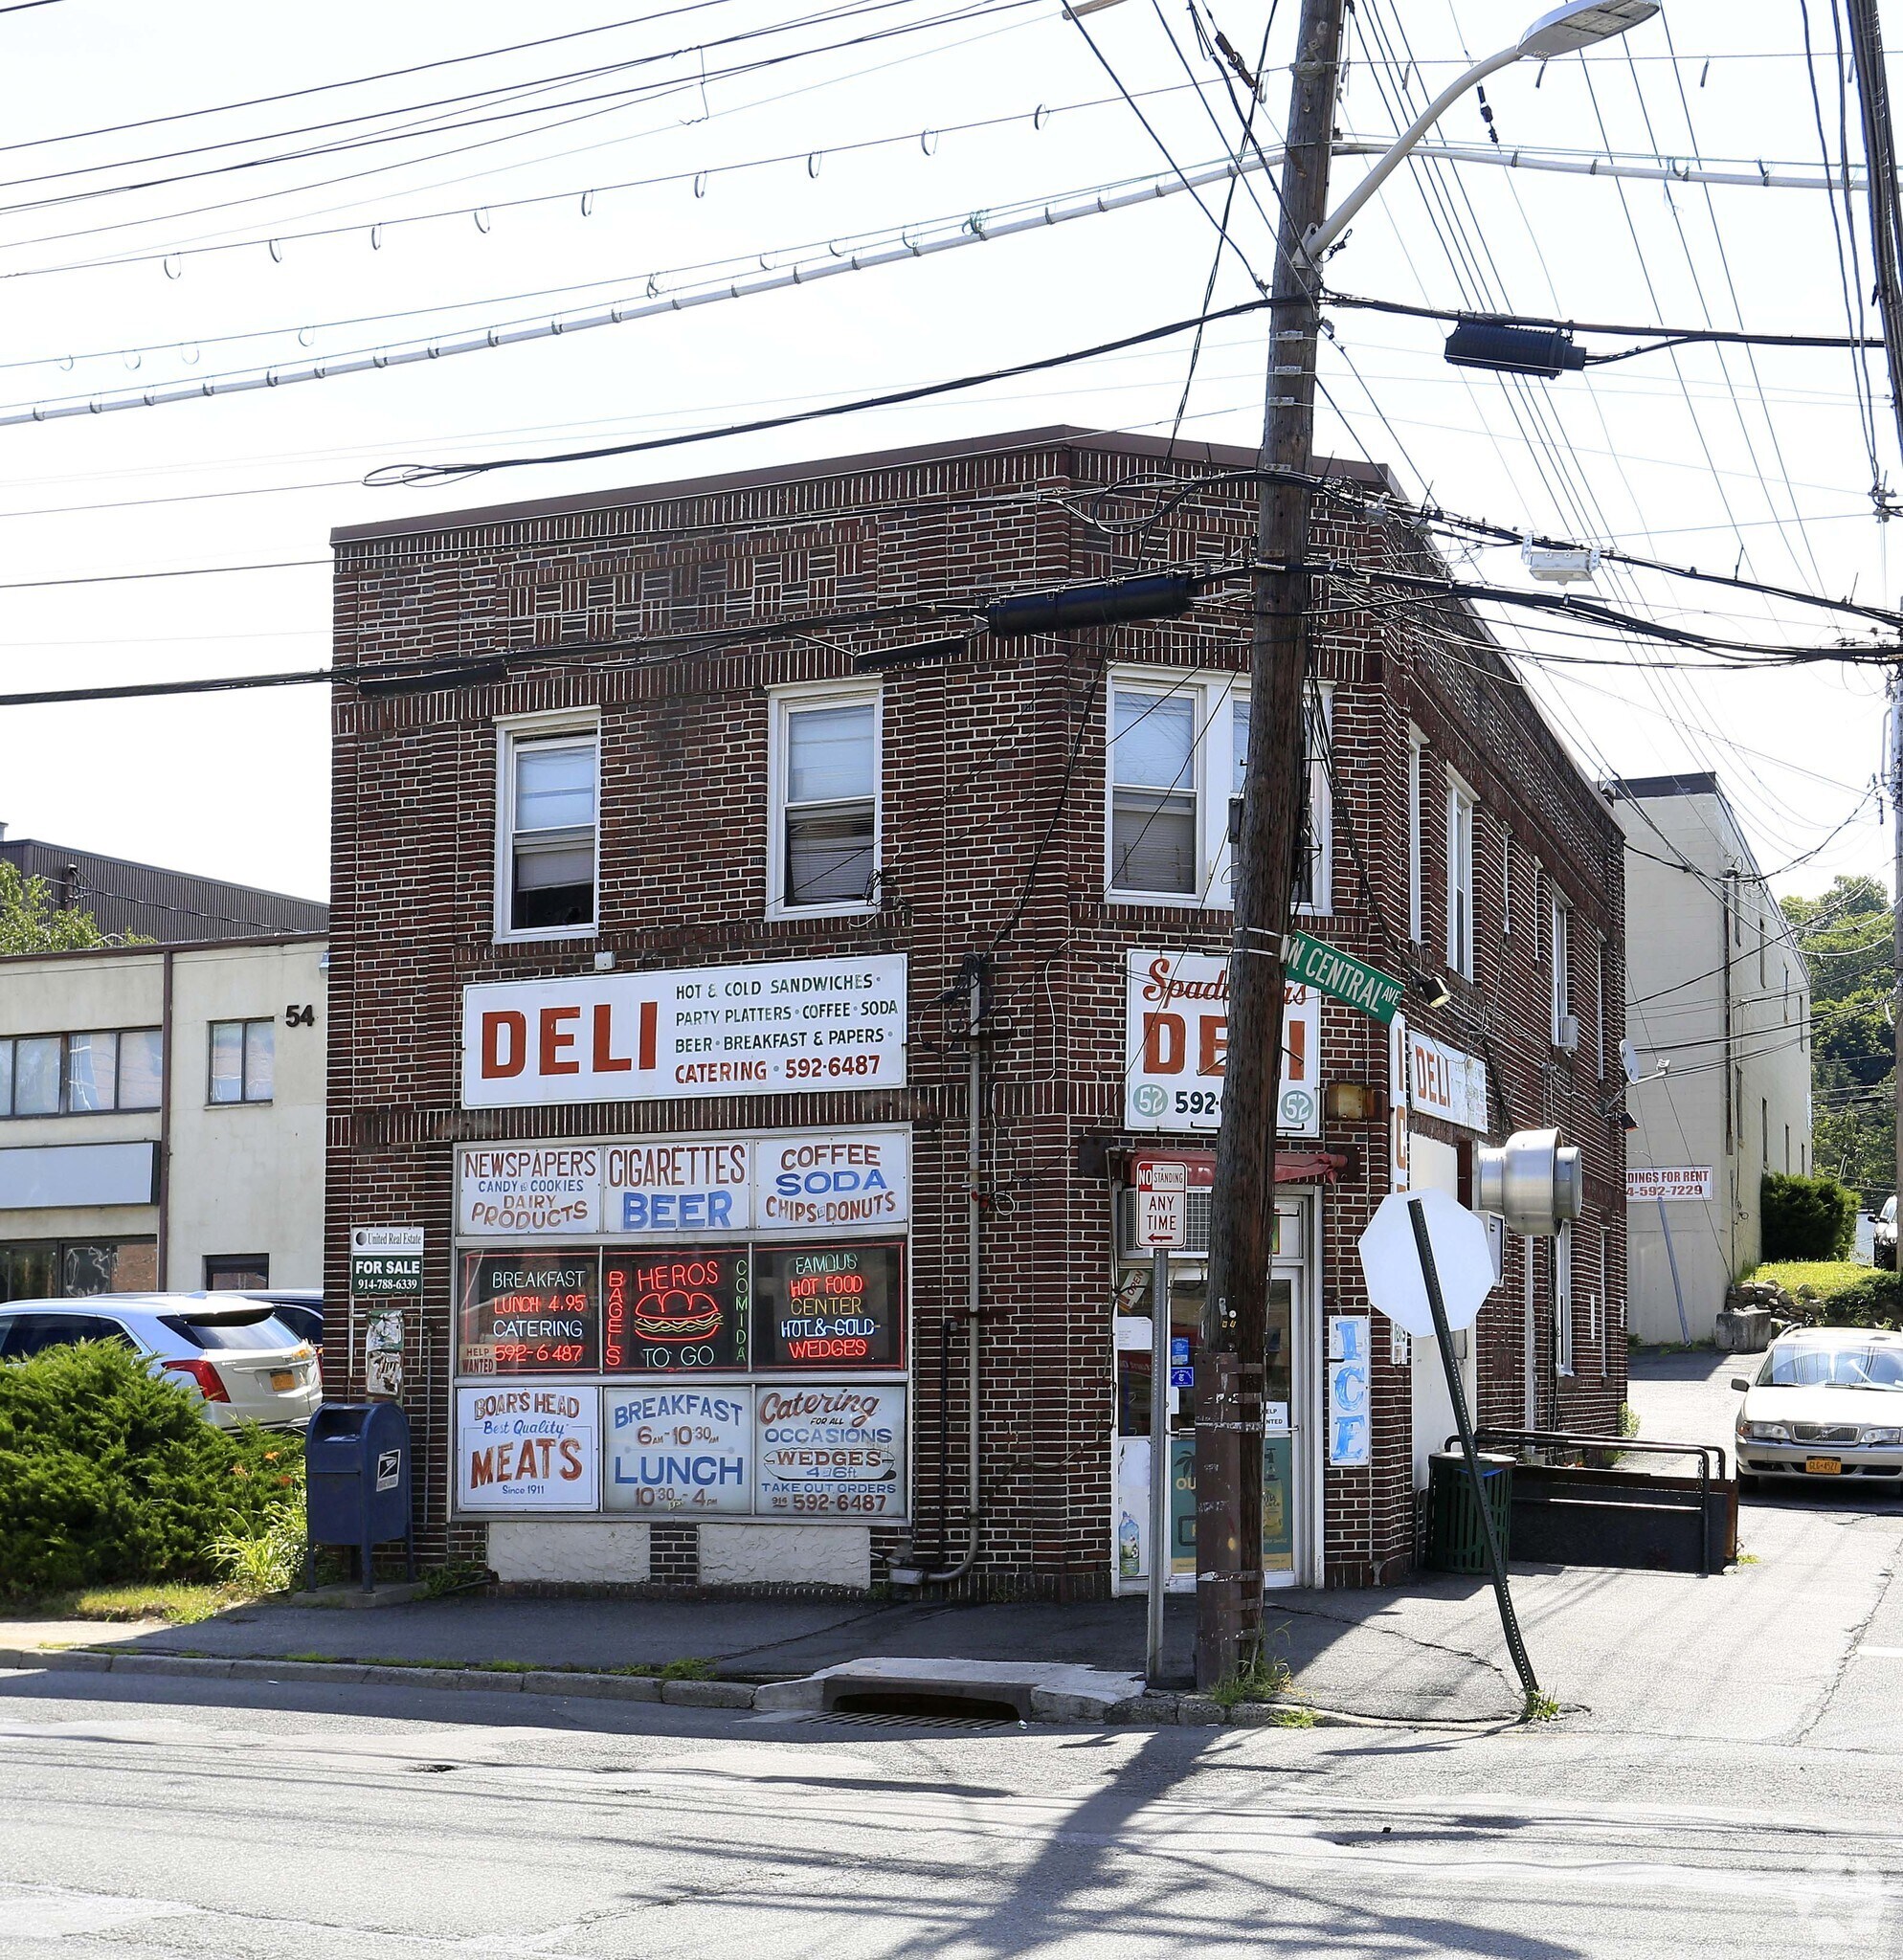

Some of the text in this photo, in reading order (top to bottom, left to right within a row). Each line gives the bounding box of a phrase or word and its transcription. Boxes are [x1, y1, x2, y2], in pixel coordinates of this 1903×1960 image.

[676, 973, 873, 1000] HOT & COLD SANDWICHES
[1305, 947, 1383, 1013] CENTRAL
[1381, 986, 1401, 1006] AVE
[285, 1005, 315, 1027] 54
[676, 1000, 899, 1026] PARTY PLATTERS COFFEE SODA
[481, 1001, 659, 1080] DELI
[675, 1028, 884, 1054] BEER BREAKFAST & PAPERS
[1143, 1012, 1305, 1081] DEI
[675, 1060, 767, 1084] CATERING
[1415, 1044, 1451, 1108] DELI
[1138, 1086, 1164, 1114] 52
[1285, 1094, 1310, 1120] 52
[464, 1150, 596, 1178] NEWSPAPERS
[609, 1145, 746, 1188] CIGARETTES
[780, 1144, 882, 1170] COFFEE
[479, 1180, 518, 1192] CANDY
[530, 1179, 584, 1192] COOKIES
[775, 1169, 887, 1196] SODA
[1139, 1169, 1183, 1186] NO STANDING
[1627, 1170, 1709, 1184] DINGS FOR RENT
[504, 1194, 556, 1209] DAIRY
[1626, 1185, 1703, 1196] 4-592-7229
[623, 1190, 732, 1229] BEER
[766, 1195, 817, 1223] CHIPS
[826, 1191, 896, 1223] DONUTS
[1149, 1195, 1175, 1211] ANY
[471, 1200, 588, 1230] PRODUCTS
[1147, 1214, 1176, 1230] TIME
[368, 1232, 421, 1244] United Real Estate
[355, 1260, 420, 1274] FOR SALE
[795, 1253, 858, 1275] FAMOUS
[358, 1279, 417, 1290] 914-788-6339
[492, 1270, 587, 1289] BREAKFAST
[638, 1260, 718, 1291] HEROS
[791, 1275, 863, 1298] HOT FOOD
[1127, 1270, 1144, 1296] OPEN
[494, 1294, 587, 1315] LUNCH 4.95
[735, 1259, 749, 1362] COMIDA
[791, 1296, 863, 1316] CENTER
[493, 1320, 583, 1338] CATERING
[606, 1270, 624, 1366] BAGELS
[781, 1319, 812, 1338] HOT
[466, 1348, 489, 1357] HELP
[494, 1344, 584, 1362] 592-6487
[642, 1346, 714, 1368] TO GO
[788, 1339, 867, 1359] WEDGES
[462, 1359, 494, 1373] WANTED
[1332, 1320, 1366, 1460] ICE
[534, 1392, 580, 1419] HEAD
[615, 1394, 743, 1429] BREAKFAST
[759, 1389, 881, 1428] Catering
[483, 1420, 510, 1435] Best
[765, 1428, 893, 1443] OCCASIONS
[470, 1437, 583, 1490] MEATS
[776, 1451, 882, 1466] WEDGES
[615, 1456, 744, 1485] LUNCH
[806, 1466, 819, 1478] 4
[502, 1484, 525, 1494] Since
[761, 1482, 897, 1494] TAKE OUT ORDERS
[793, 1493, 886, 1512] 592-6487
